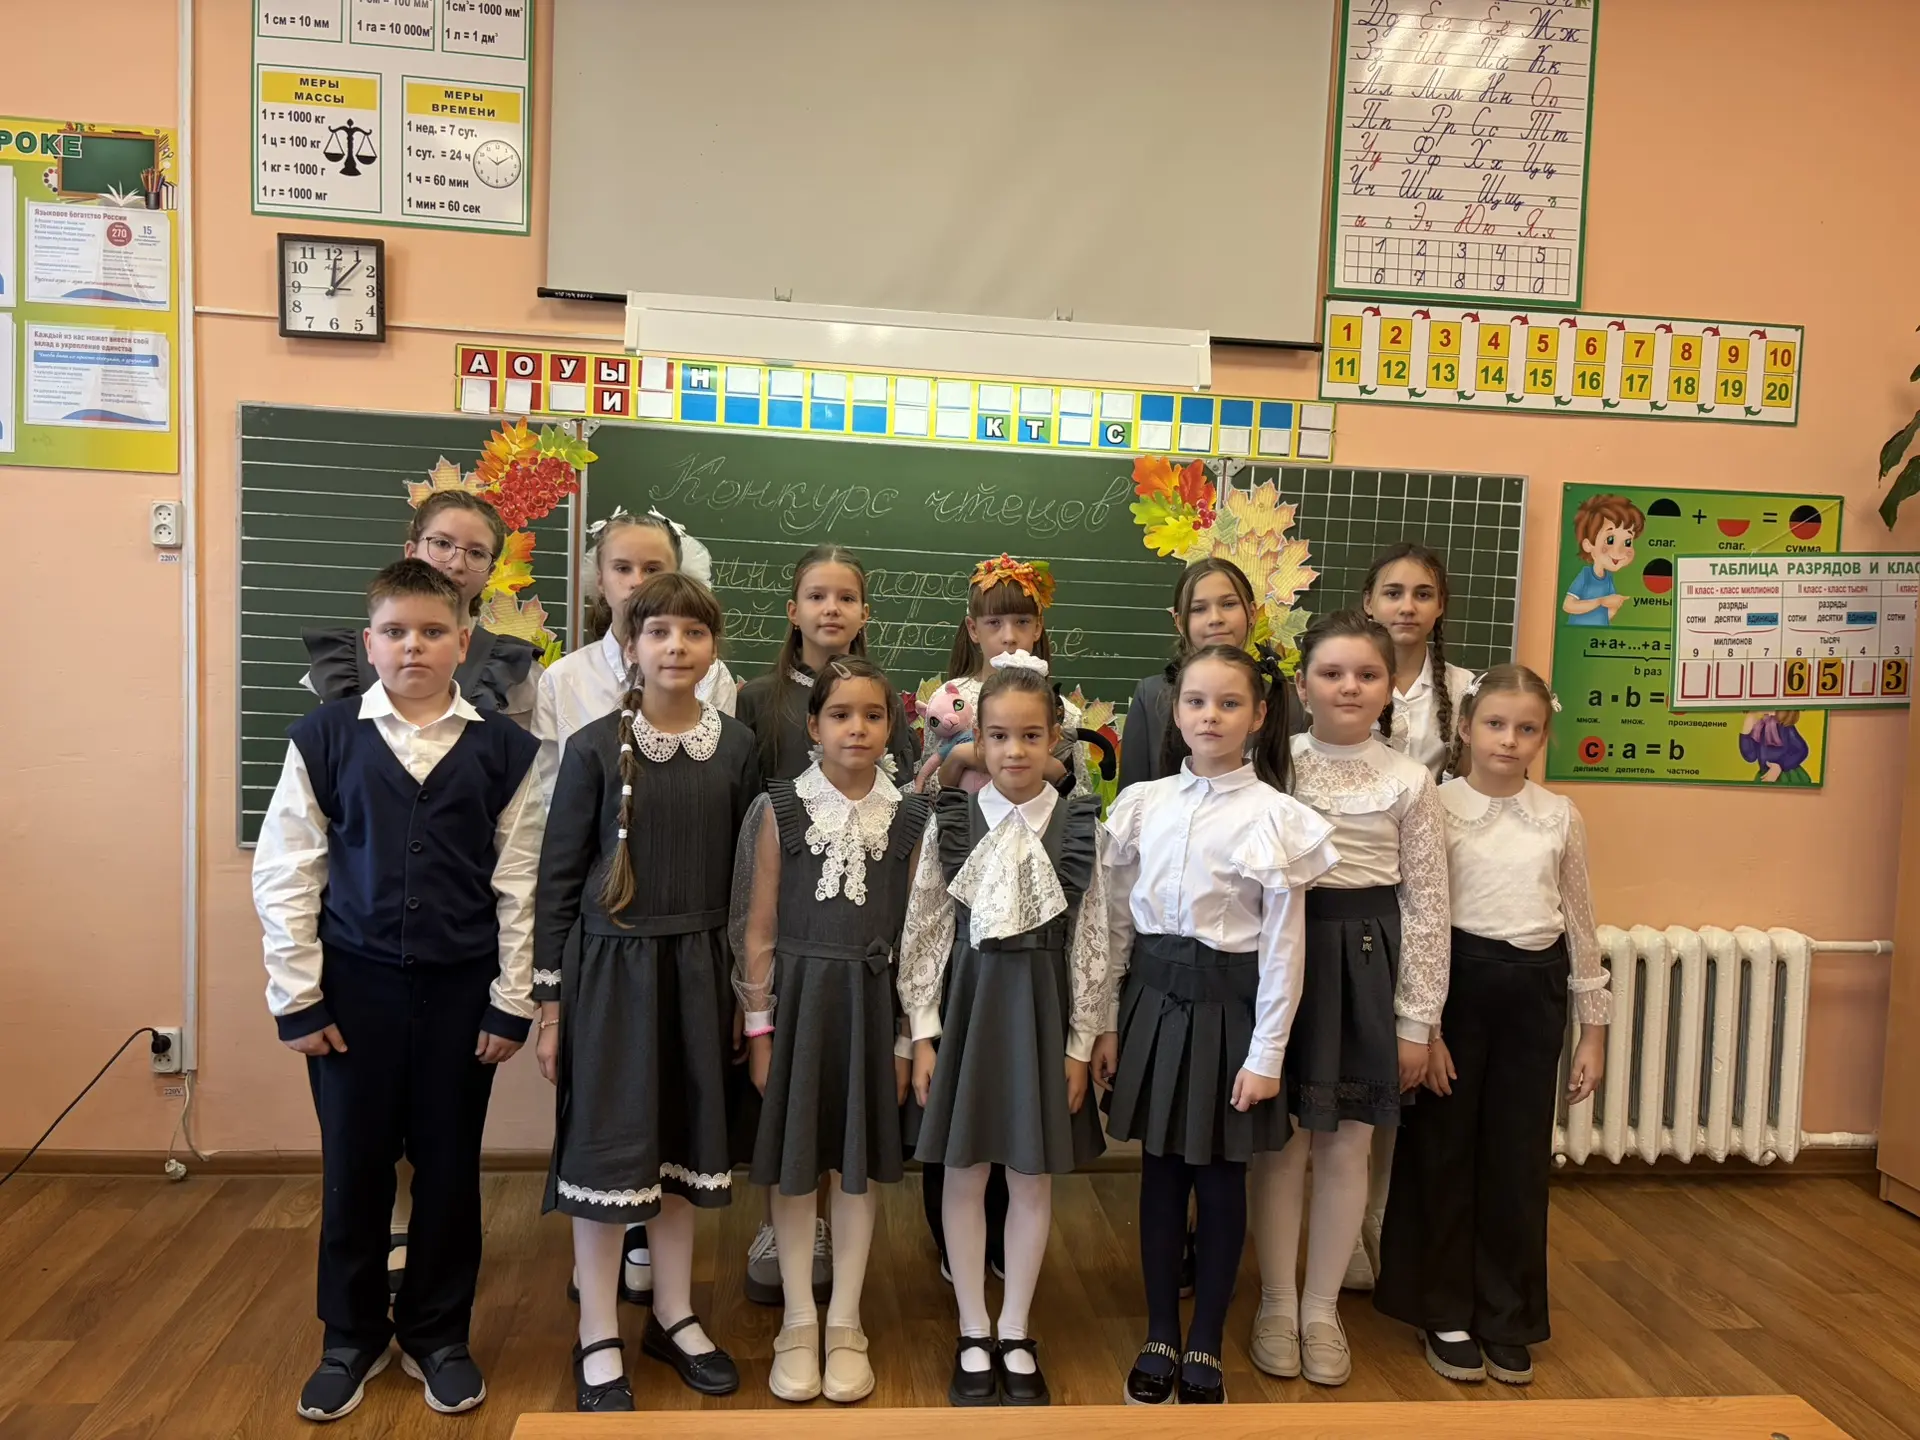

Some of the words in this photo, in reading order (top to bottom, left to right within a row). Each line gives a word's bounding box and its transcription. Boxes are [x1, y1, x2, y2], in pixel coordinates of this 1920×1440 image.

[264, 13, 269, 24] 1
[272, 16, 287, 25] см
[299, 15, 311, 27] 10
[314, 19, 330, 28] мм
[445, 28, 450, 39] 1
[454, 31, 460, 40] л
[472, 30, 478, 42] 1
[299, 77, 340, 89] МЕРЫ
[294, 91, 344, 104] МАССЫ
[444, 90, 484, 102] МЕРЫ
[262, 109, 267, 120] 1
[270, 112, 278, 121] т
[287, 110, 312, 124] 1000
[315, 114, 326, 125] кг
[432, 104, 496, 118] ВРЕМЕНИ
[407, 121, 412, 132] 1
[416, 124, 438, 136] нед.
[449, 124, 455, 136] 7
[458, 128, 478, 140] сут.
[262, 134, 267, 146] 1
[270, 138, 278, 148] ц
[290, 136, 308, 148] 100
[310, 138, 321, 150] кг
[407, 146, 412, 157] 1
[416, 149, 435, 160] сут.
[450, 148, 462, 161] 24
[465, 152, 471, 162] ч
[262, 161, 267, 173] 1
[271, 164, 282, 175] кг
[294, 162, 318, 176] 1000
[320, 166, 326, 176] г
[407, 173, 412, 184] 1
[416, 175, 422, 184] ч
[433, 174, 446, 187] 60
[448, 177, 469, 189] мин
[262, 186, 267, 198] 1
[271, 189, 277, 198] г
[288, 187, 312, 200] 1000
[315, 192, 328, 202] мг
[407, 197, 412, 208] 1
[416, 200, 436, 210] мин
[448, 200, 460, 213] 60
[462, 202, 481, 214] сек
[103, 213, 128, 221] России
[112, 228, 127, 238] 270
[142, 226, 152, 236] 15
[300, 246, 316, 260] 11
[324, 248, 342, 261] 12
[353, 250, 362, 262] 1
[292, 261, 308, 274] 10
[366, 265, 375, 278] 2
[292, 280, 301, 294] 9
[366, 285, 375, 298] 3
[292, 300, 302, 313] 8
[366, 305, 376, 318] 4
[305, 316, 314, 328] 7
[330, 318, 340, 330] 6
[354, 319, 364, 332] 5
[1343, 322, 1352, 342] 1
[1390, 326, 1402, 344] 2
[1440, 328, 1451, 348] 3
[1488, 332, 1500, 350] 4
[1537, 334, 1549, 352] 5
[1585, 336, 1597, 356] 6
[1634, 340, 1646, 358] 7
[1680, 342, 1692, 360] 8
[1728, 346, 1740, 364] 9
[1770, 348, 1792, 367] 10
[468, 353, 491, 374] А
[512, 356, 535, 376] О
[558, 358, 578, 378] У
[600, 362, 628, 383] Ы
[688, 367, 710, 388] Н
[1335, 356, 1356, 377] 11
[1382, 360, 1406, 380] 12
[1432, 362, 1456, 382] 13
[1480, 366, 1504, 385] 14
[1530, 368, 1552, 388] 15
[1578, 370, 1600, 390] 16
[1626, 374, 1649, 392] 17
[1673, 376, 1696, 395] 18
[1720, 379, 1743, 398] 19
[1766, 382, 1789, 401] 20
[602, 390, 623, 412] И
[985, 416, 1005, 438] К
[1026, 418, 1044, 440] Т
[1105, 422, 1126, 444] С
[649, 452, 899, 535] Конкурс
[926, 476, 1134, 539] чтецов
[1648, 538, 1676, 548] слаг.
[1718, 542, 1746, 551] слаг.
[1786, 544, 1822, 552] сумма
[1710, 562, 1778, 577] ТАБЛИЦА
[1787, 562, 1861, 577] РАЗРЯДОВ
[1870, 562, 1879, 574] И
[1695, 587, 1715, 595] класс
[1720, 586, 1740, 594] класс
[1741, 586, 1780, 594] миллионов
[1804, 586, 1823, 594] класс
[1828, 585, 1847, 594] класс
[1848, 585, 1868, 593] тысяч
[1718, 602, 1748, 612] разряды
[1818, 601, 1848, 610] разряды
[1686, 616, 1706, 624] сотни
[1714, 615, 1742, 624] десятки
[1788, 614, 1807, 622] сотни
[1817, 614, 1844, 622] десятки
[1887, 614, 1906, 622] сотни
[1714, 638, 1752, 646] миллионов
[1820, 636, 1841, 645] тысяч
[1693, 648, 1698, 658] 9
[1728, 648, 1734, 657] 8
[1764, 648, 1770, 657] 7
[1796, 647, 1802, 656] 6
[1828, 647, 1834, 656] 5
[1860, 646, 1866, 655] 4
[1894, 646, 1900, 655] 3
[1644, 668, 1662, 678] раз
[1788, 662, 1804, 691] 6
[1822, 662, 1838, 690] 5
[1886, 660, 1902, 690] 3
[1668, 720, 1728, 728] произведение
[1573, 766, 1610, 774] делимое
